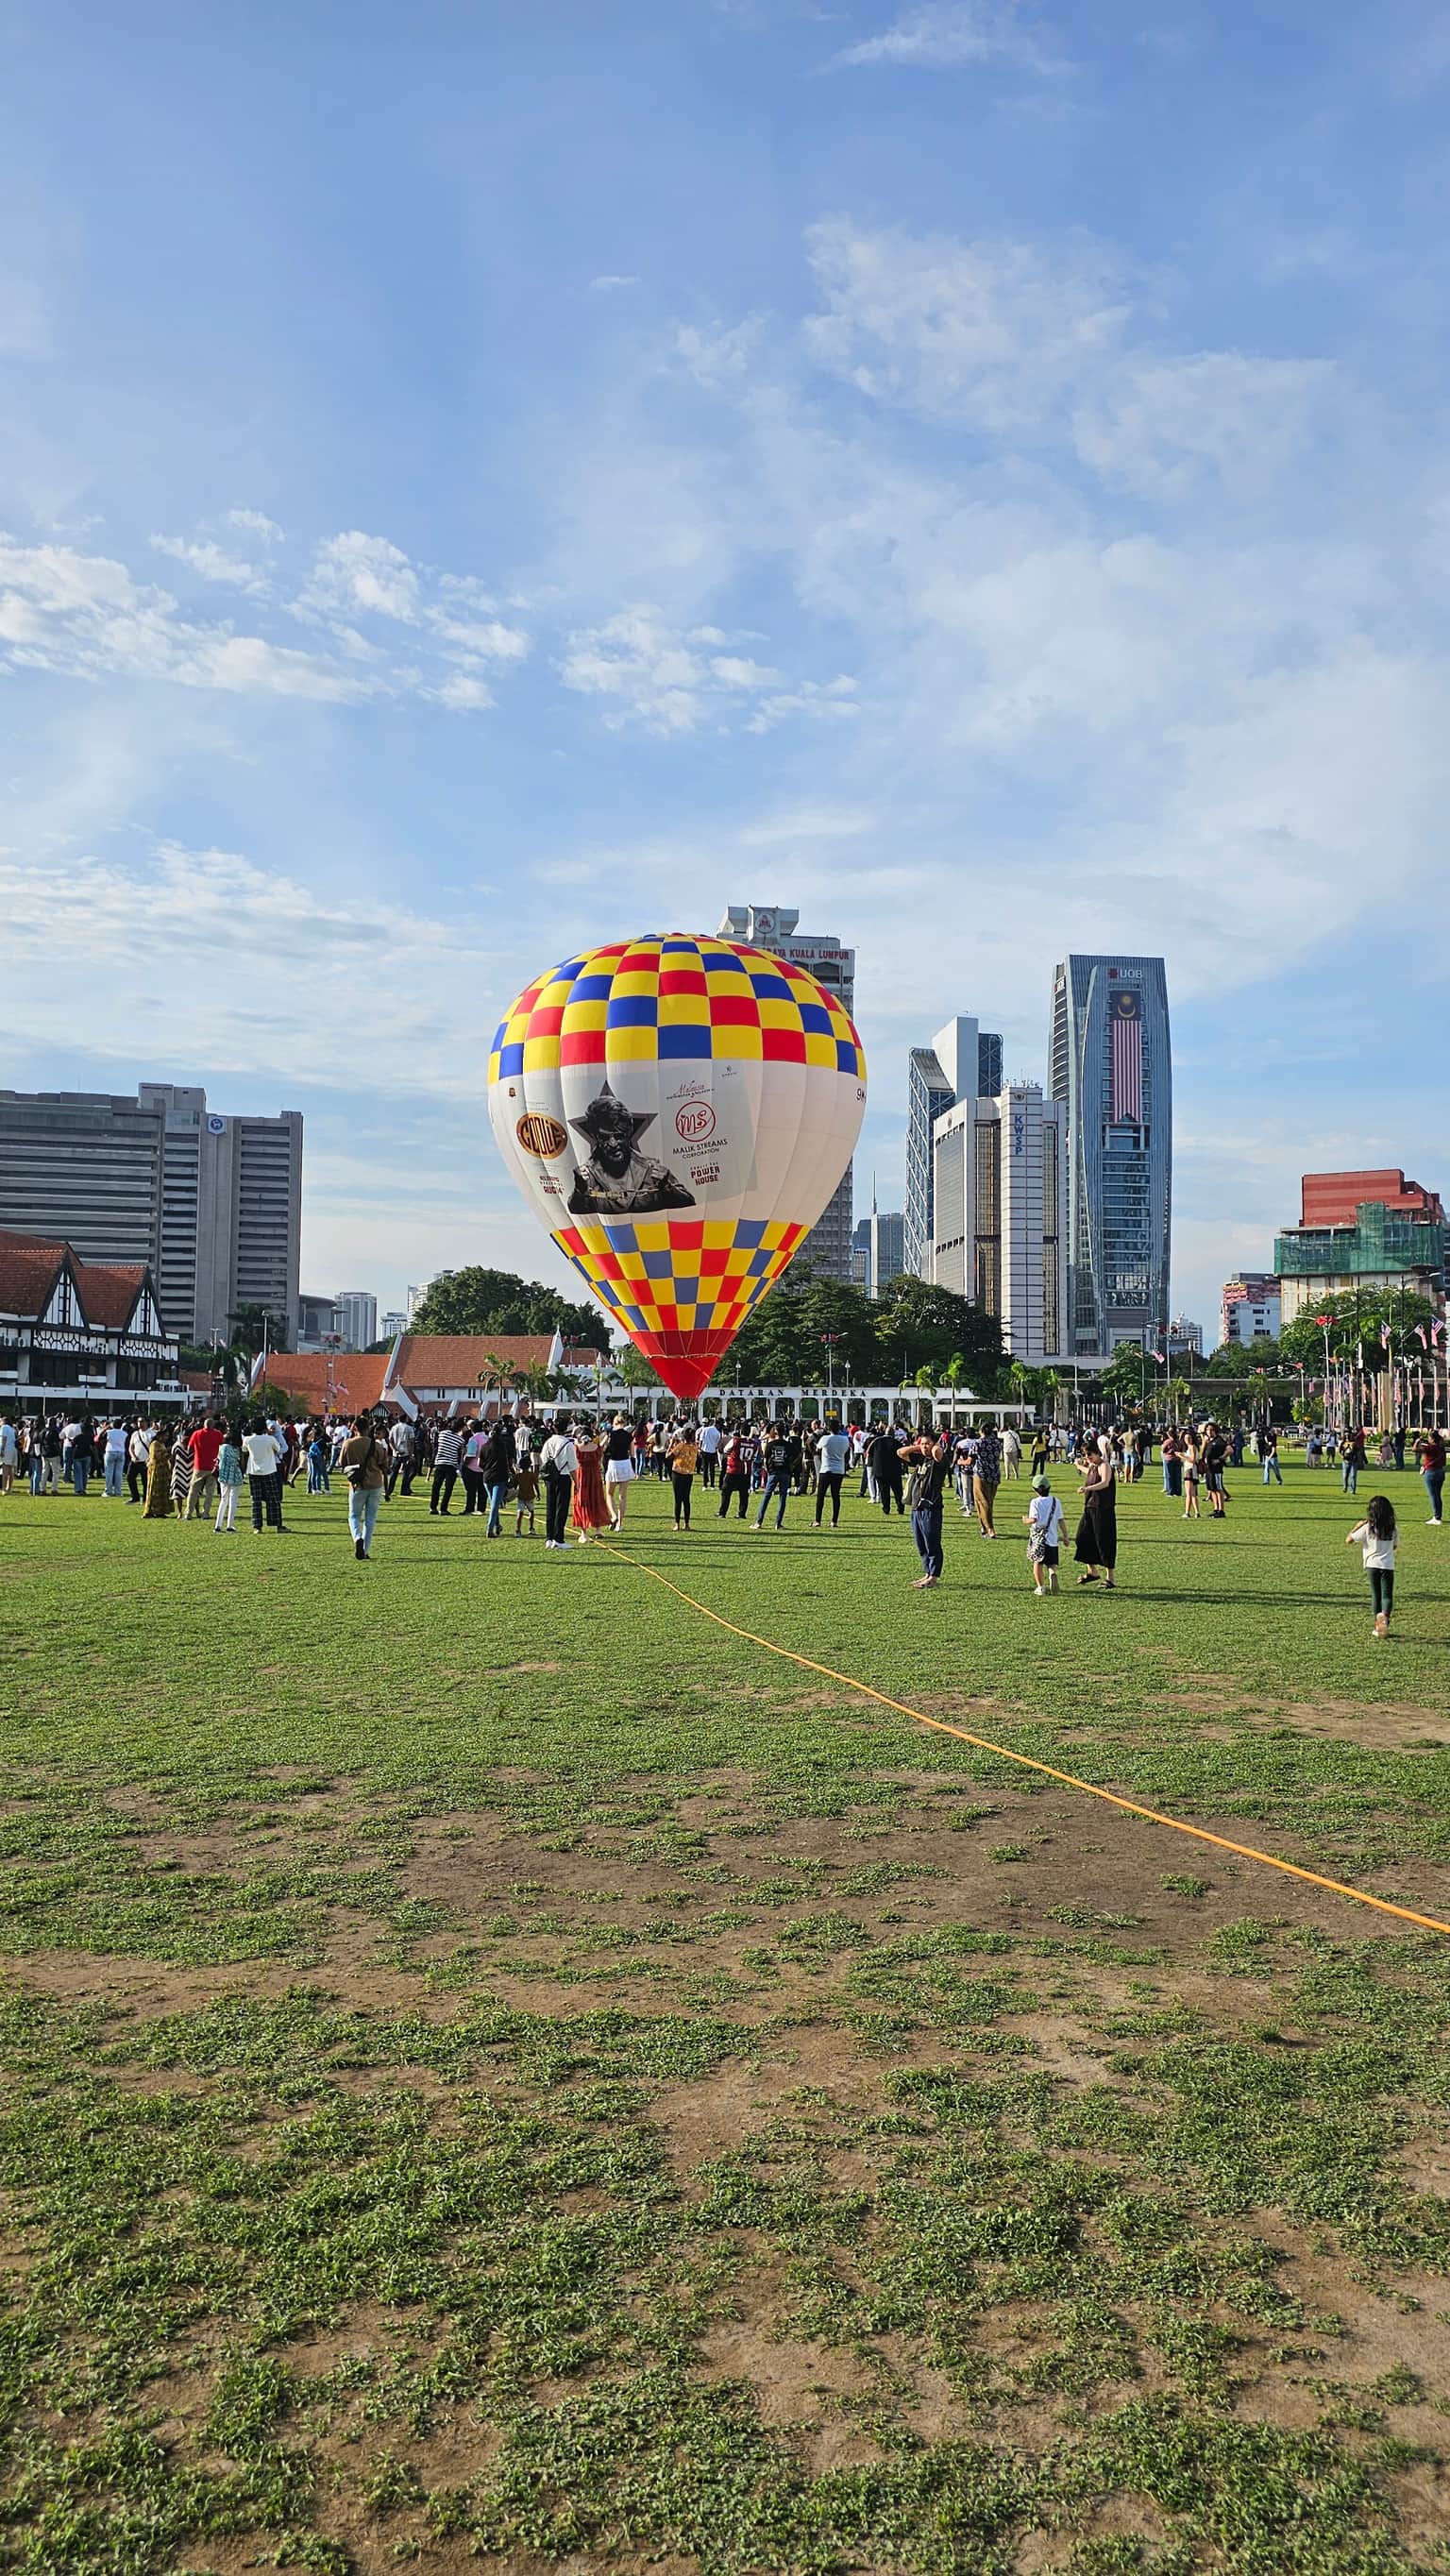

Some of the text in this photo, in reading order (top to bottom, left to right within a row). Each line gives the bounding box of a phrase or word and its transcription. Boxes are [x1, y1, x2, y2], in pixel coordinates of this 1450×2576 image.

[789, 948, 816, 958] KUALA
[818, 950, 850, 960] LUMPUR
[1120, 969, 1142, 978] UOB
[1014, 1115, 1024, 1155] KWSP
[672, 1139, 728, 1155] MALIK STREAMS
[682, 1147, 719, 1160] CORPORATION
[690, 1165, 720, 1178] POWER
[695, 1174, 718, 1186] HOUSE
